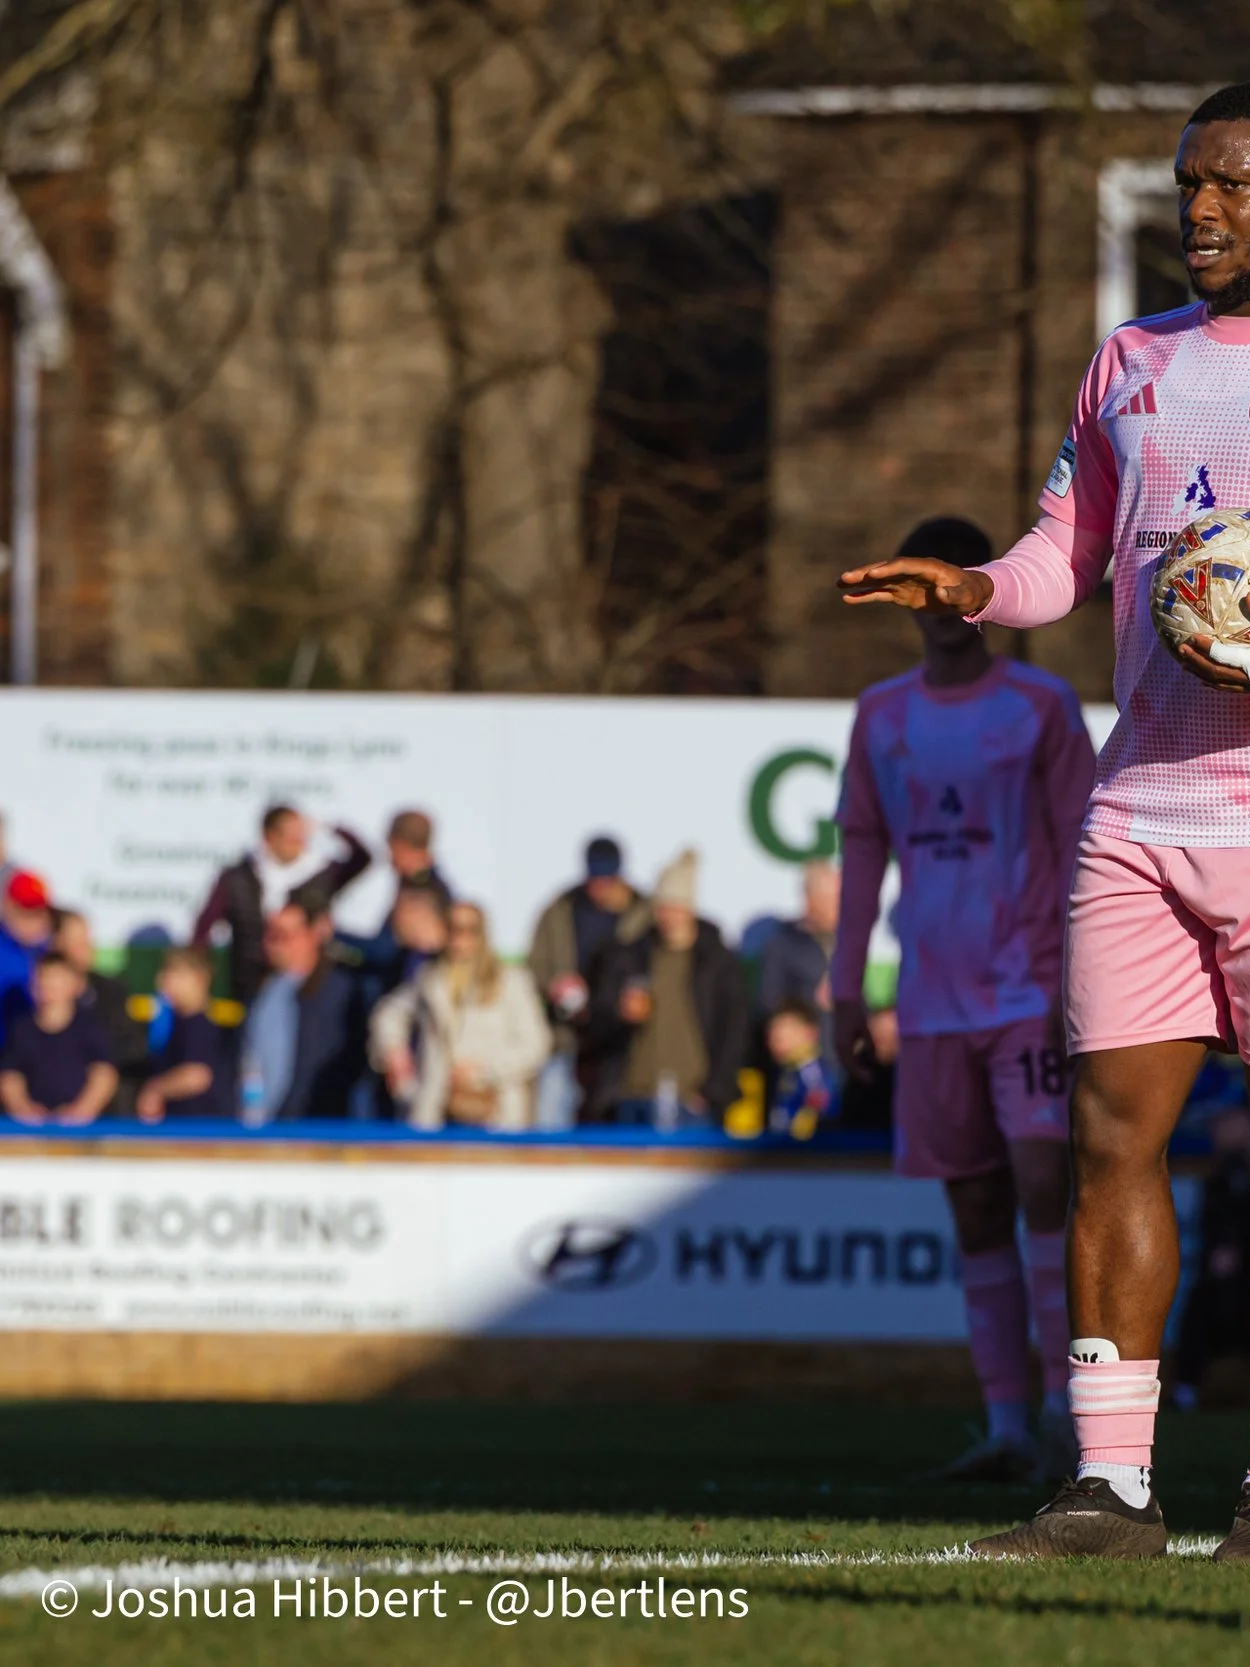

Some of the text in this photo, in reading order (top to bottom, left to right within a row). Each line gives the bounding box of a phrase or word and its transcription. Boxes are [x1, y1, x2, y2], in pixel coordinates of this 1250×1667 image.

[1136, 531, 1177, 549] REGION
[1017, 1047, 1066, 1096] 18
[113, 1195, 388, 1254] ROOFING
[672, 1227, 962, 1285] HYUND
